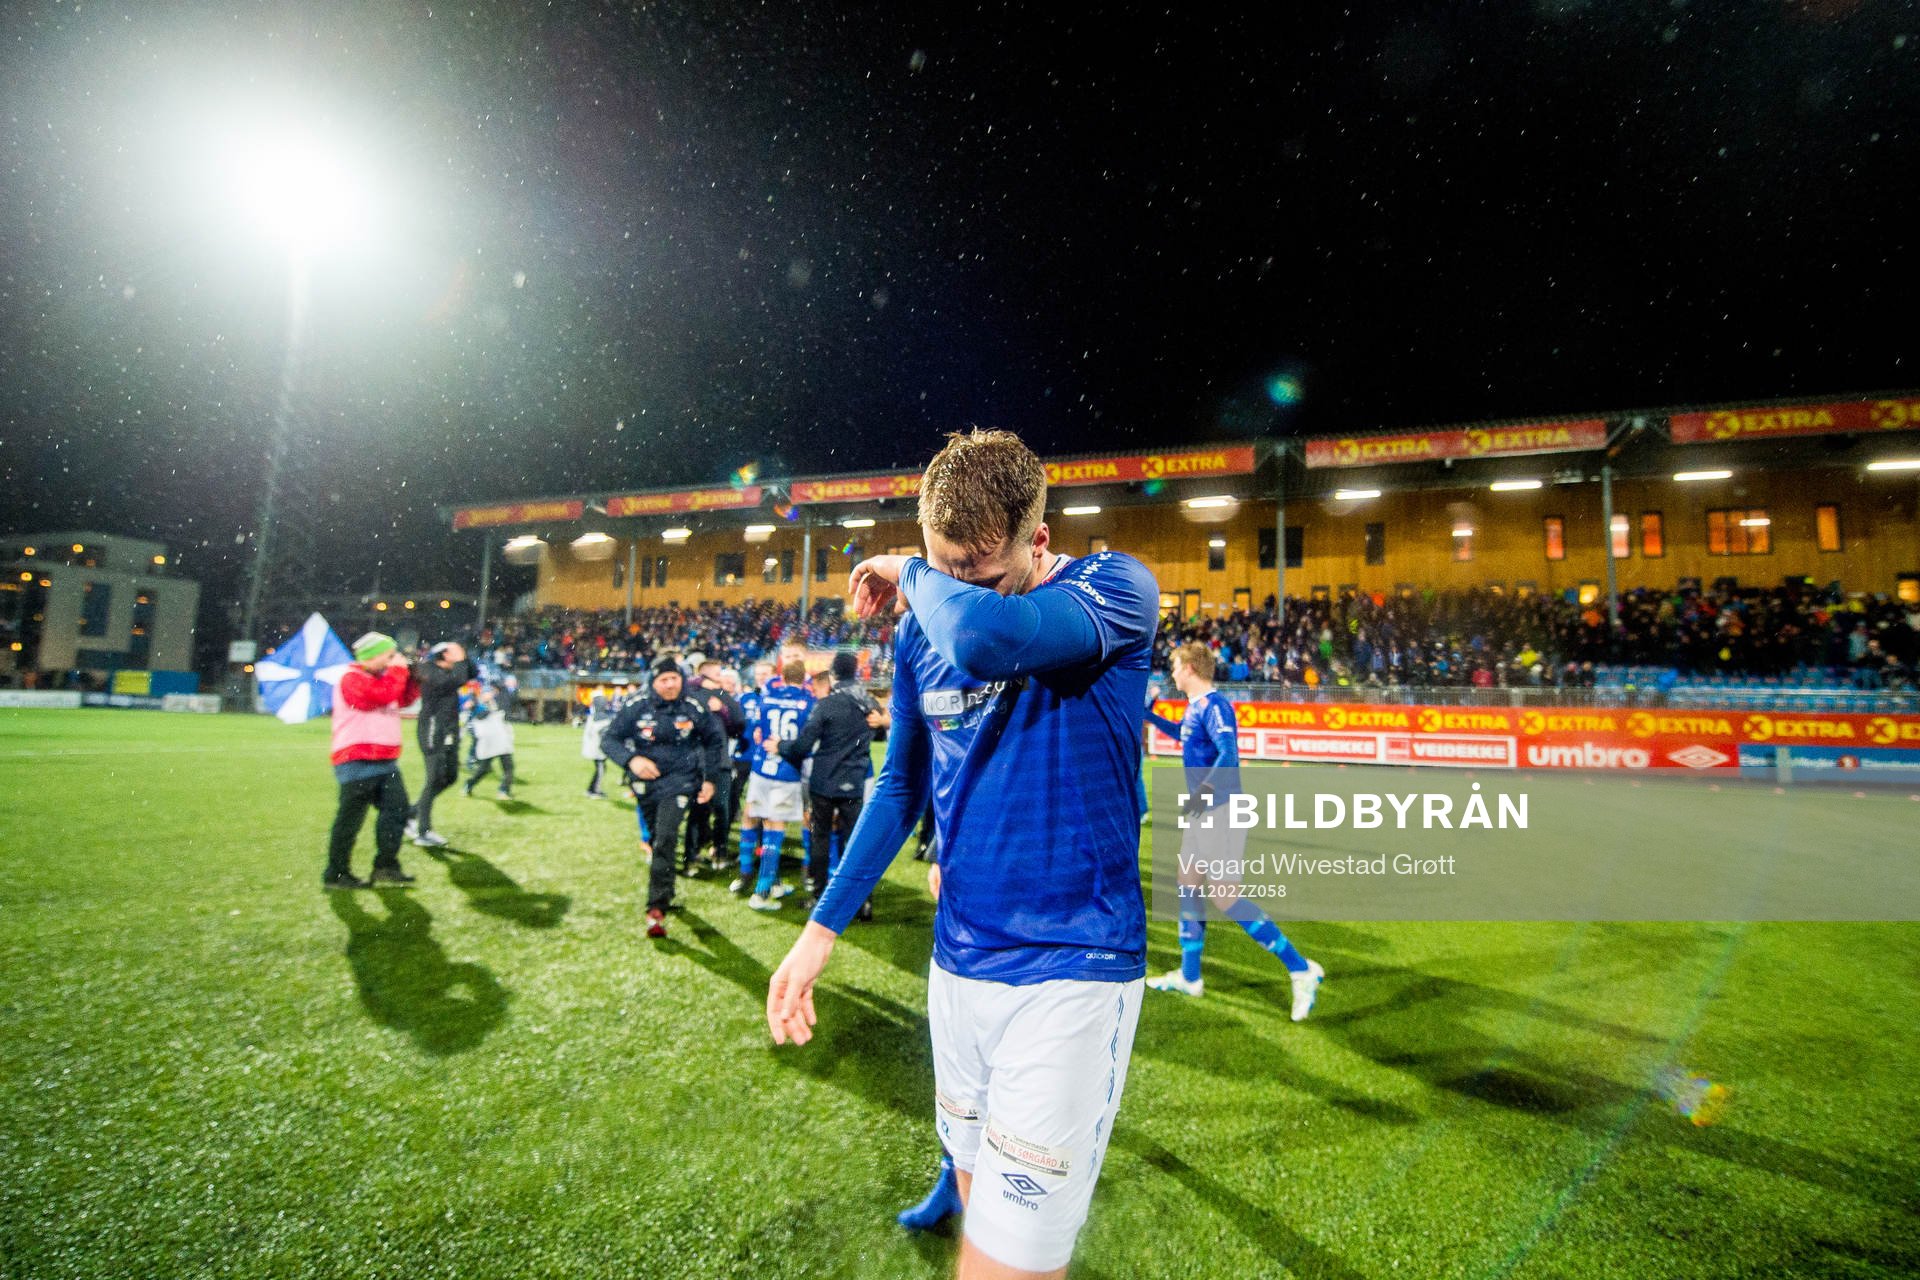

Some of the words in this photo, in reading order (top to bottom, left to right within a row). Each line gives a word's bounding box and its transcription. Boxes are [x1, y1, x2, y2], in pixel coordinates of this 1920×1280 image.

[1741, 410, 1835, 431] EXTRA
[1362, 439, 1432, 457] EXTRA
[1494, 428, 1570, 448] EXTRA
[1063, 463, 1118, 480] EXTRA
[1166, 455, 1226, 473] EXTRA
[766, 708, 799, 741] 16
[1259, 710, 1316, 724] EXTRA
[1350, 711, 1409, 727] EXTRA
[1444, 713, 1511, 729] EXTRA
[1548, 715, 1617, 731] EXTRA
[1657, 717, 1733, 736] EXTRA
[1775, 720, 1855, 739] EXTRA
[1289, 738, 1375, 754] VEIDEKKE
[1412, 743, 1507, 759] VEIDEKKE
[1527, 742, 1649, 769] umbro
[1003, 1190, 1038, 1211] umbro
